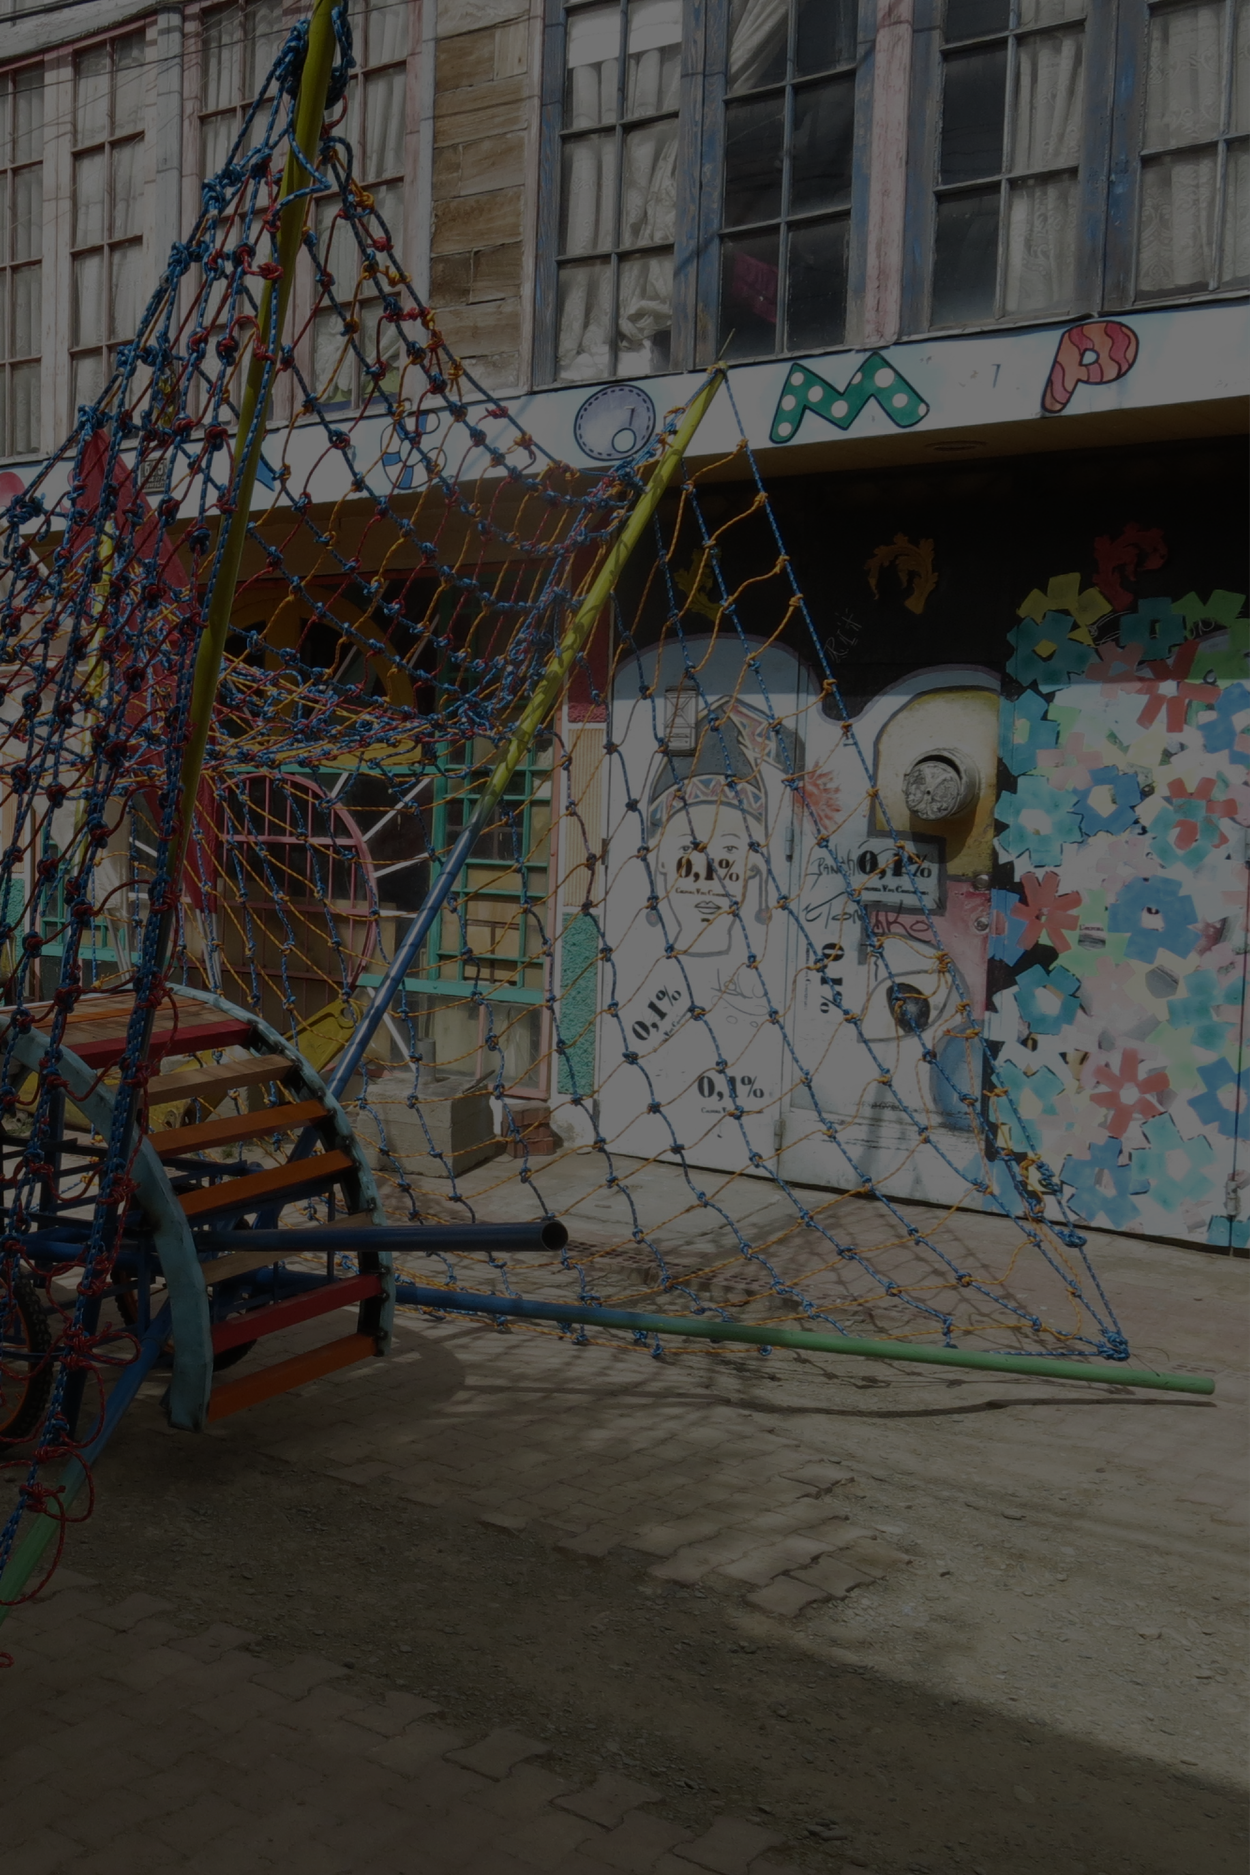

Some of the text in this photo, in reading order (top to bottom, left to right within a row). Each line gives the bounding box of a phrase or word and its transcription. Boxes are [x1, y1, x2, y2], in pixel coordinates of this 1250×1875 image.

[676, 856, 740, 883] 0,1%
[632, 985, 681, 1041] 0,1%
[697, 1075, 764, 1101] 0,1%
